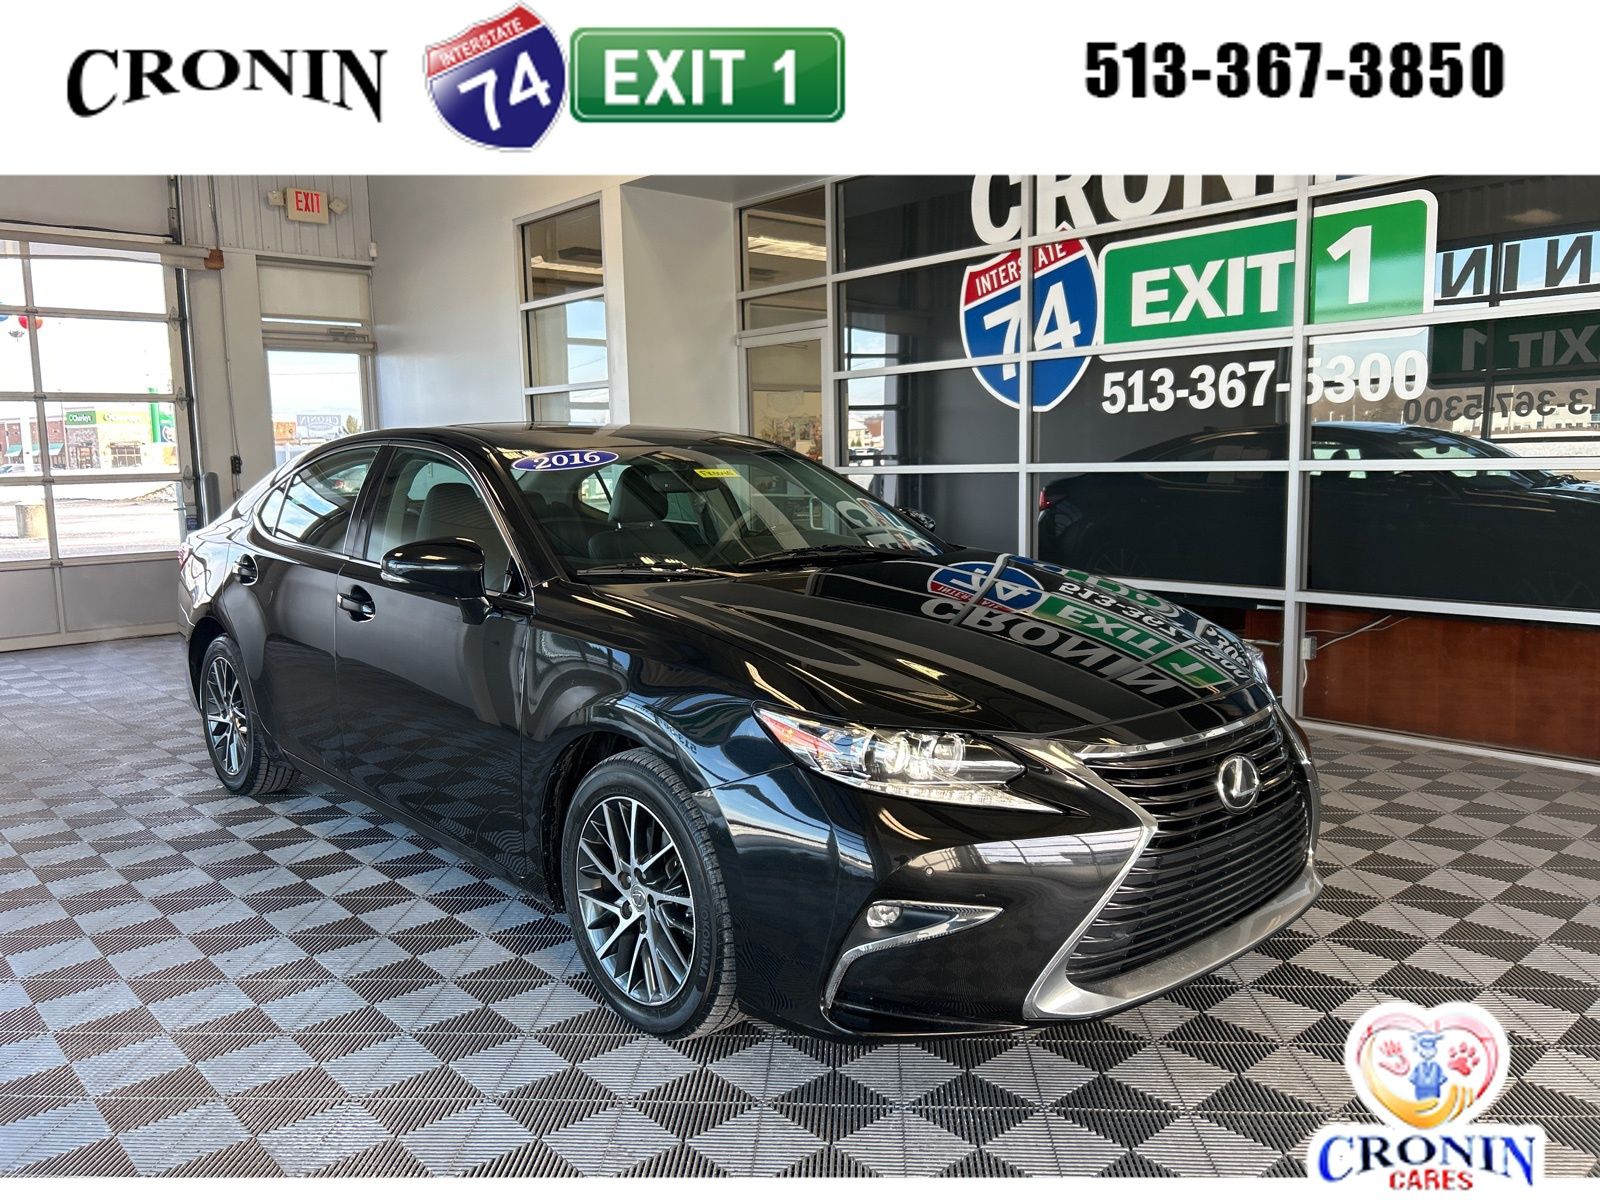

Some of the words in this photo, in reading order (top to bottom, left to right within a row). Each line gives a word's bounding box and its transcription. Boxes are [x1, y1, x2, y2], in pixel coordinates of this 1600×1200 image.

[294, 190, 321, 214] EXIT
[976, 242, 1068, 297] INTERSATE
[1131, 249, 1296, 328] EXIT
[1326, 225, 1372, 305] 1
[983, 281, 1082, 382] 74
[1101, 349, 1429, 415] 513-367-5300
[533, 451, 601, 470] 2016
